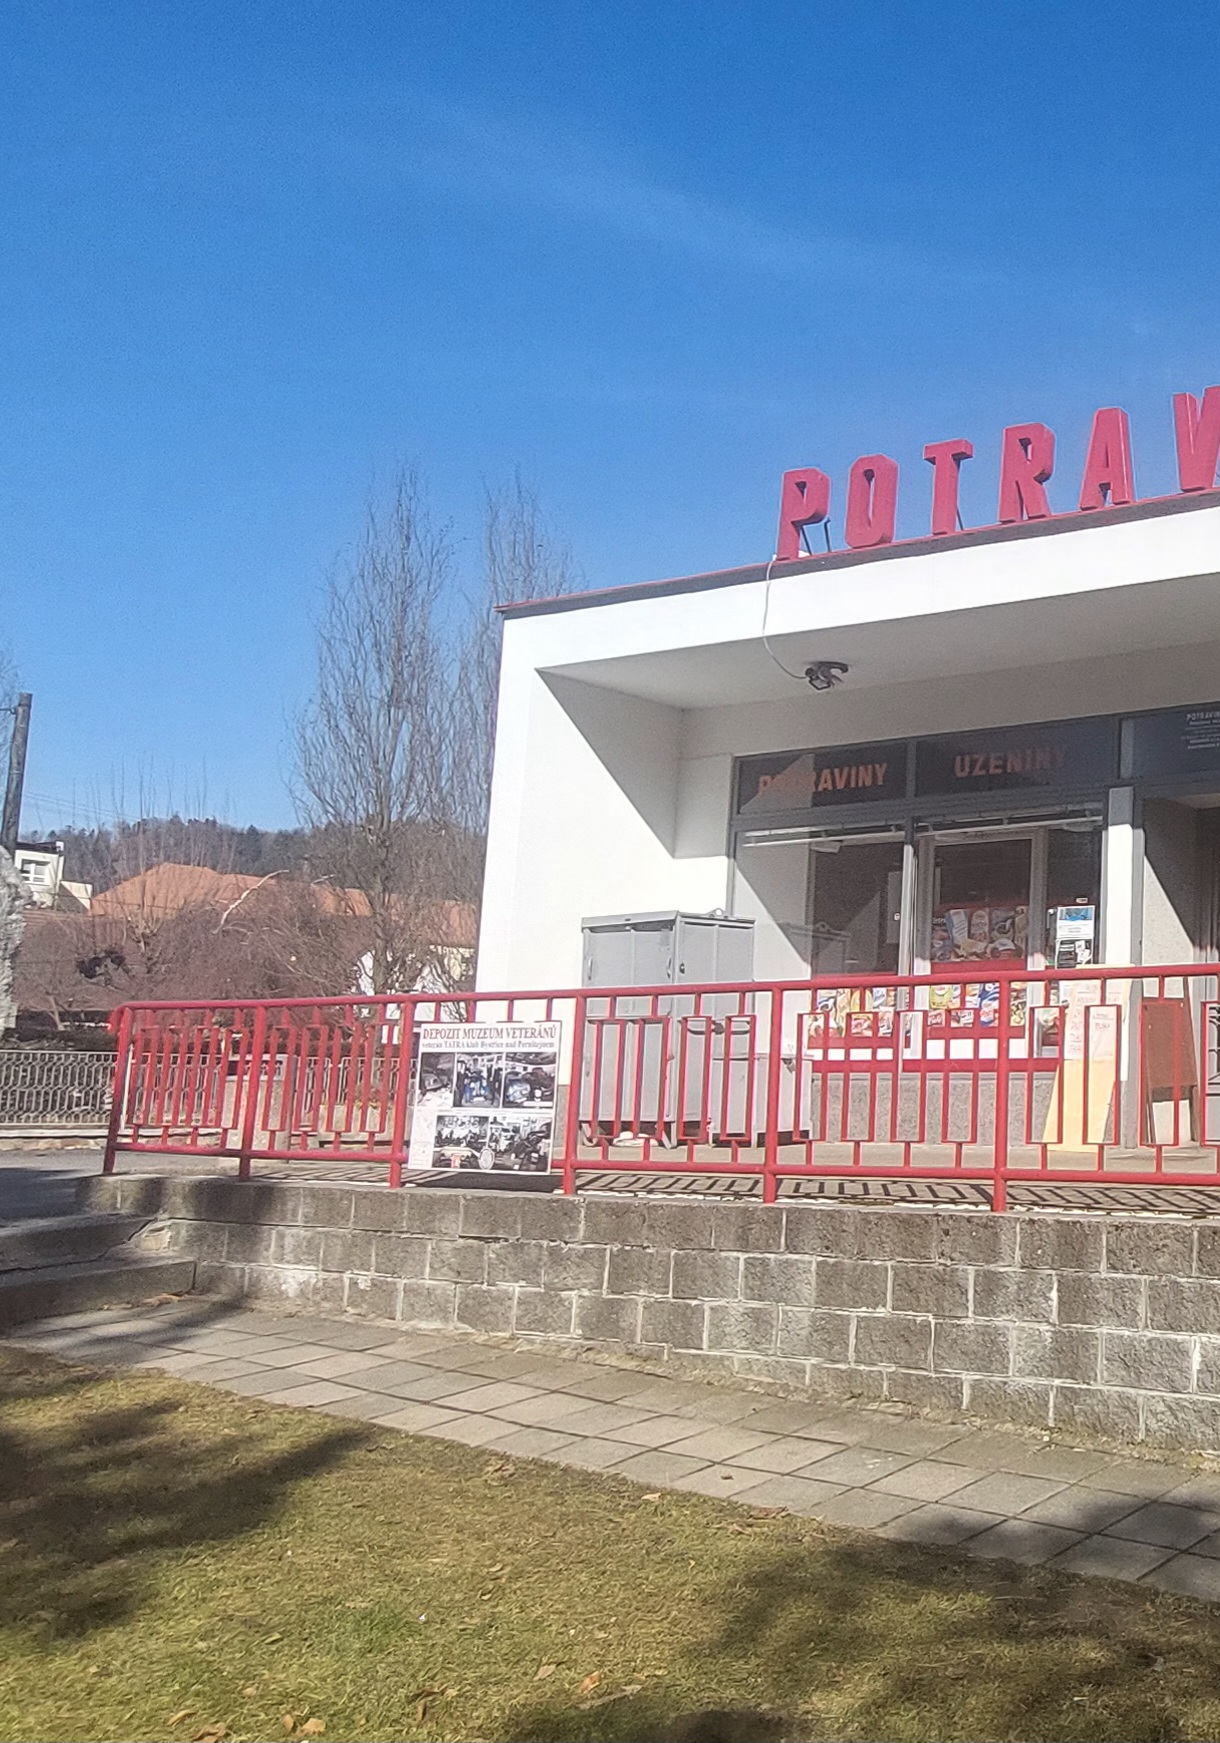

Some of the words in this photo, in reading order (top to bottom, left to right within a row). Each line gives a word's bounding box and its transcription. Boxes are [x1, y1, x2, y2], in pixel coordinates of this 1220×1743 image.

[759, 763, 887, 793] PAVINY
[423, 1028, 461, 1039] DEPOZIT
[462, 1028, 503, 1039] MUZEUM
